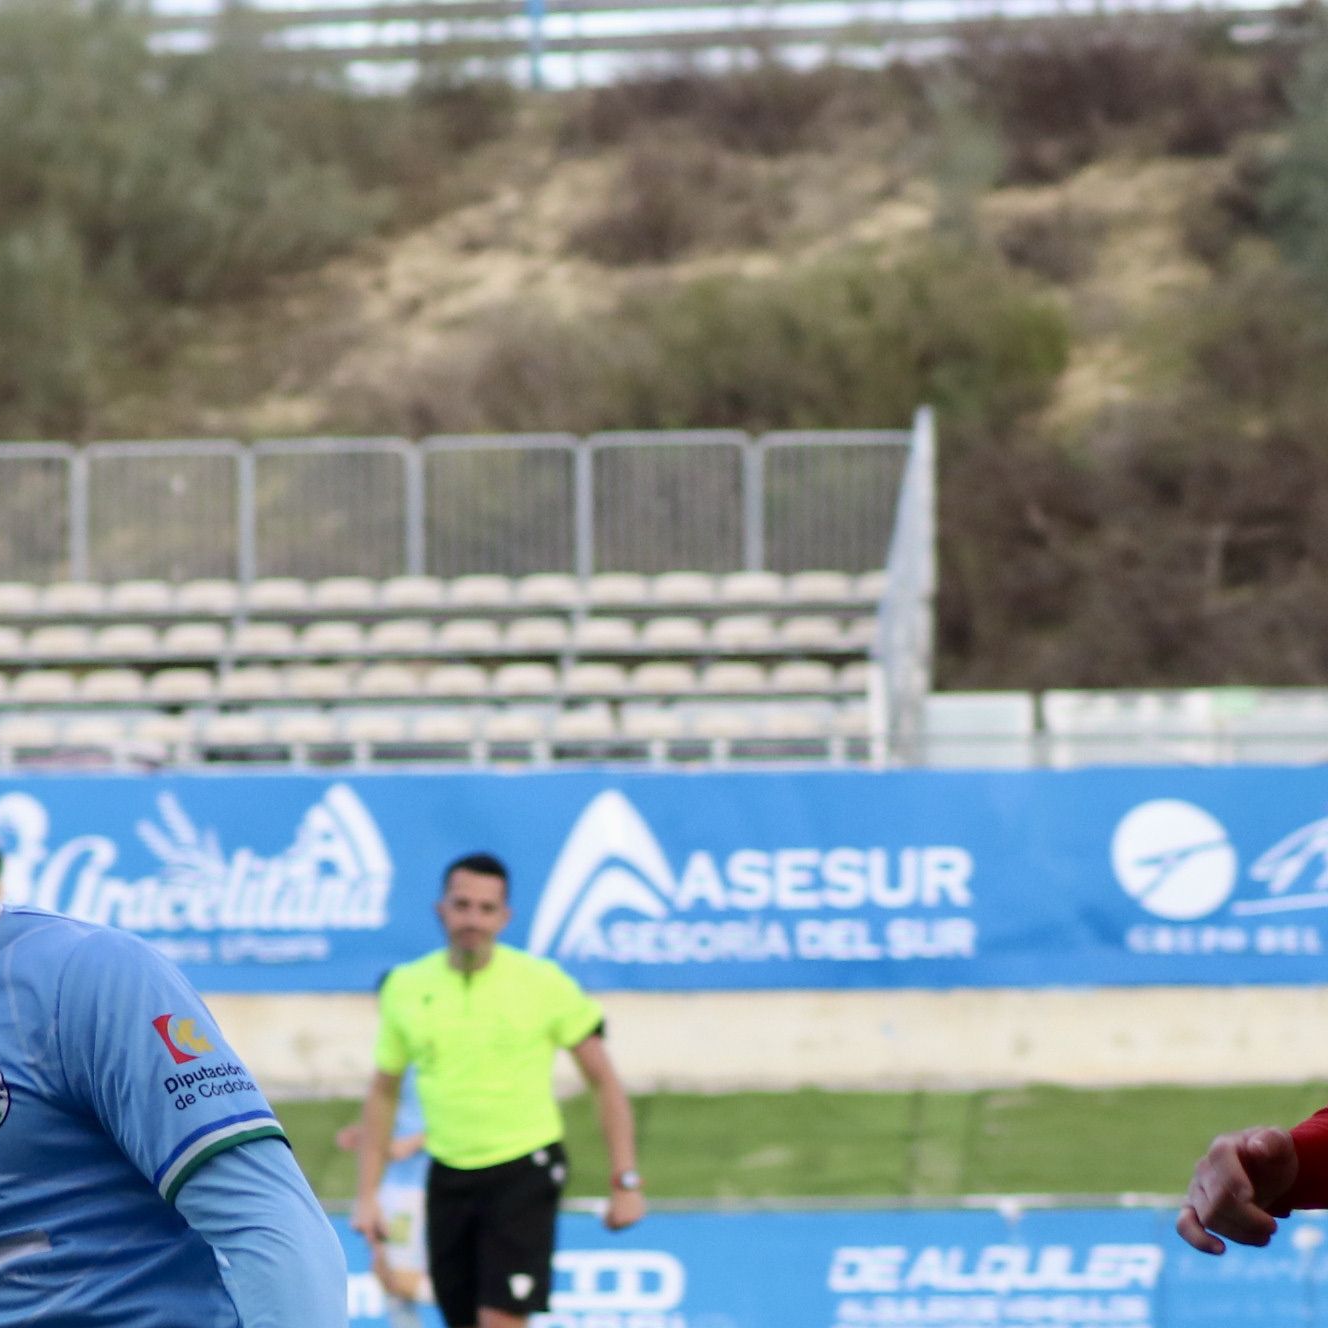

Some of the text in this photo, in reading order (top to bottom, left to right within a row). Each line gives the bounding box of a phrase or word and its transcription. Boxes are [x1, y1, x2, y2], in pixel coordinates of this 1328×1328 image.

[675, 847, 972, 910] ASESUR
[795, 919, 880, 960] DEL
[885, 918, 974, 959] SUR
[164, 1062, 245, 1095] Diputación
[175, 1075, 257, 1111] de Córdoba
[828, 1247, 910, 1292] DE
[906, 1244, 1164, 1296] ALQUILER
